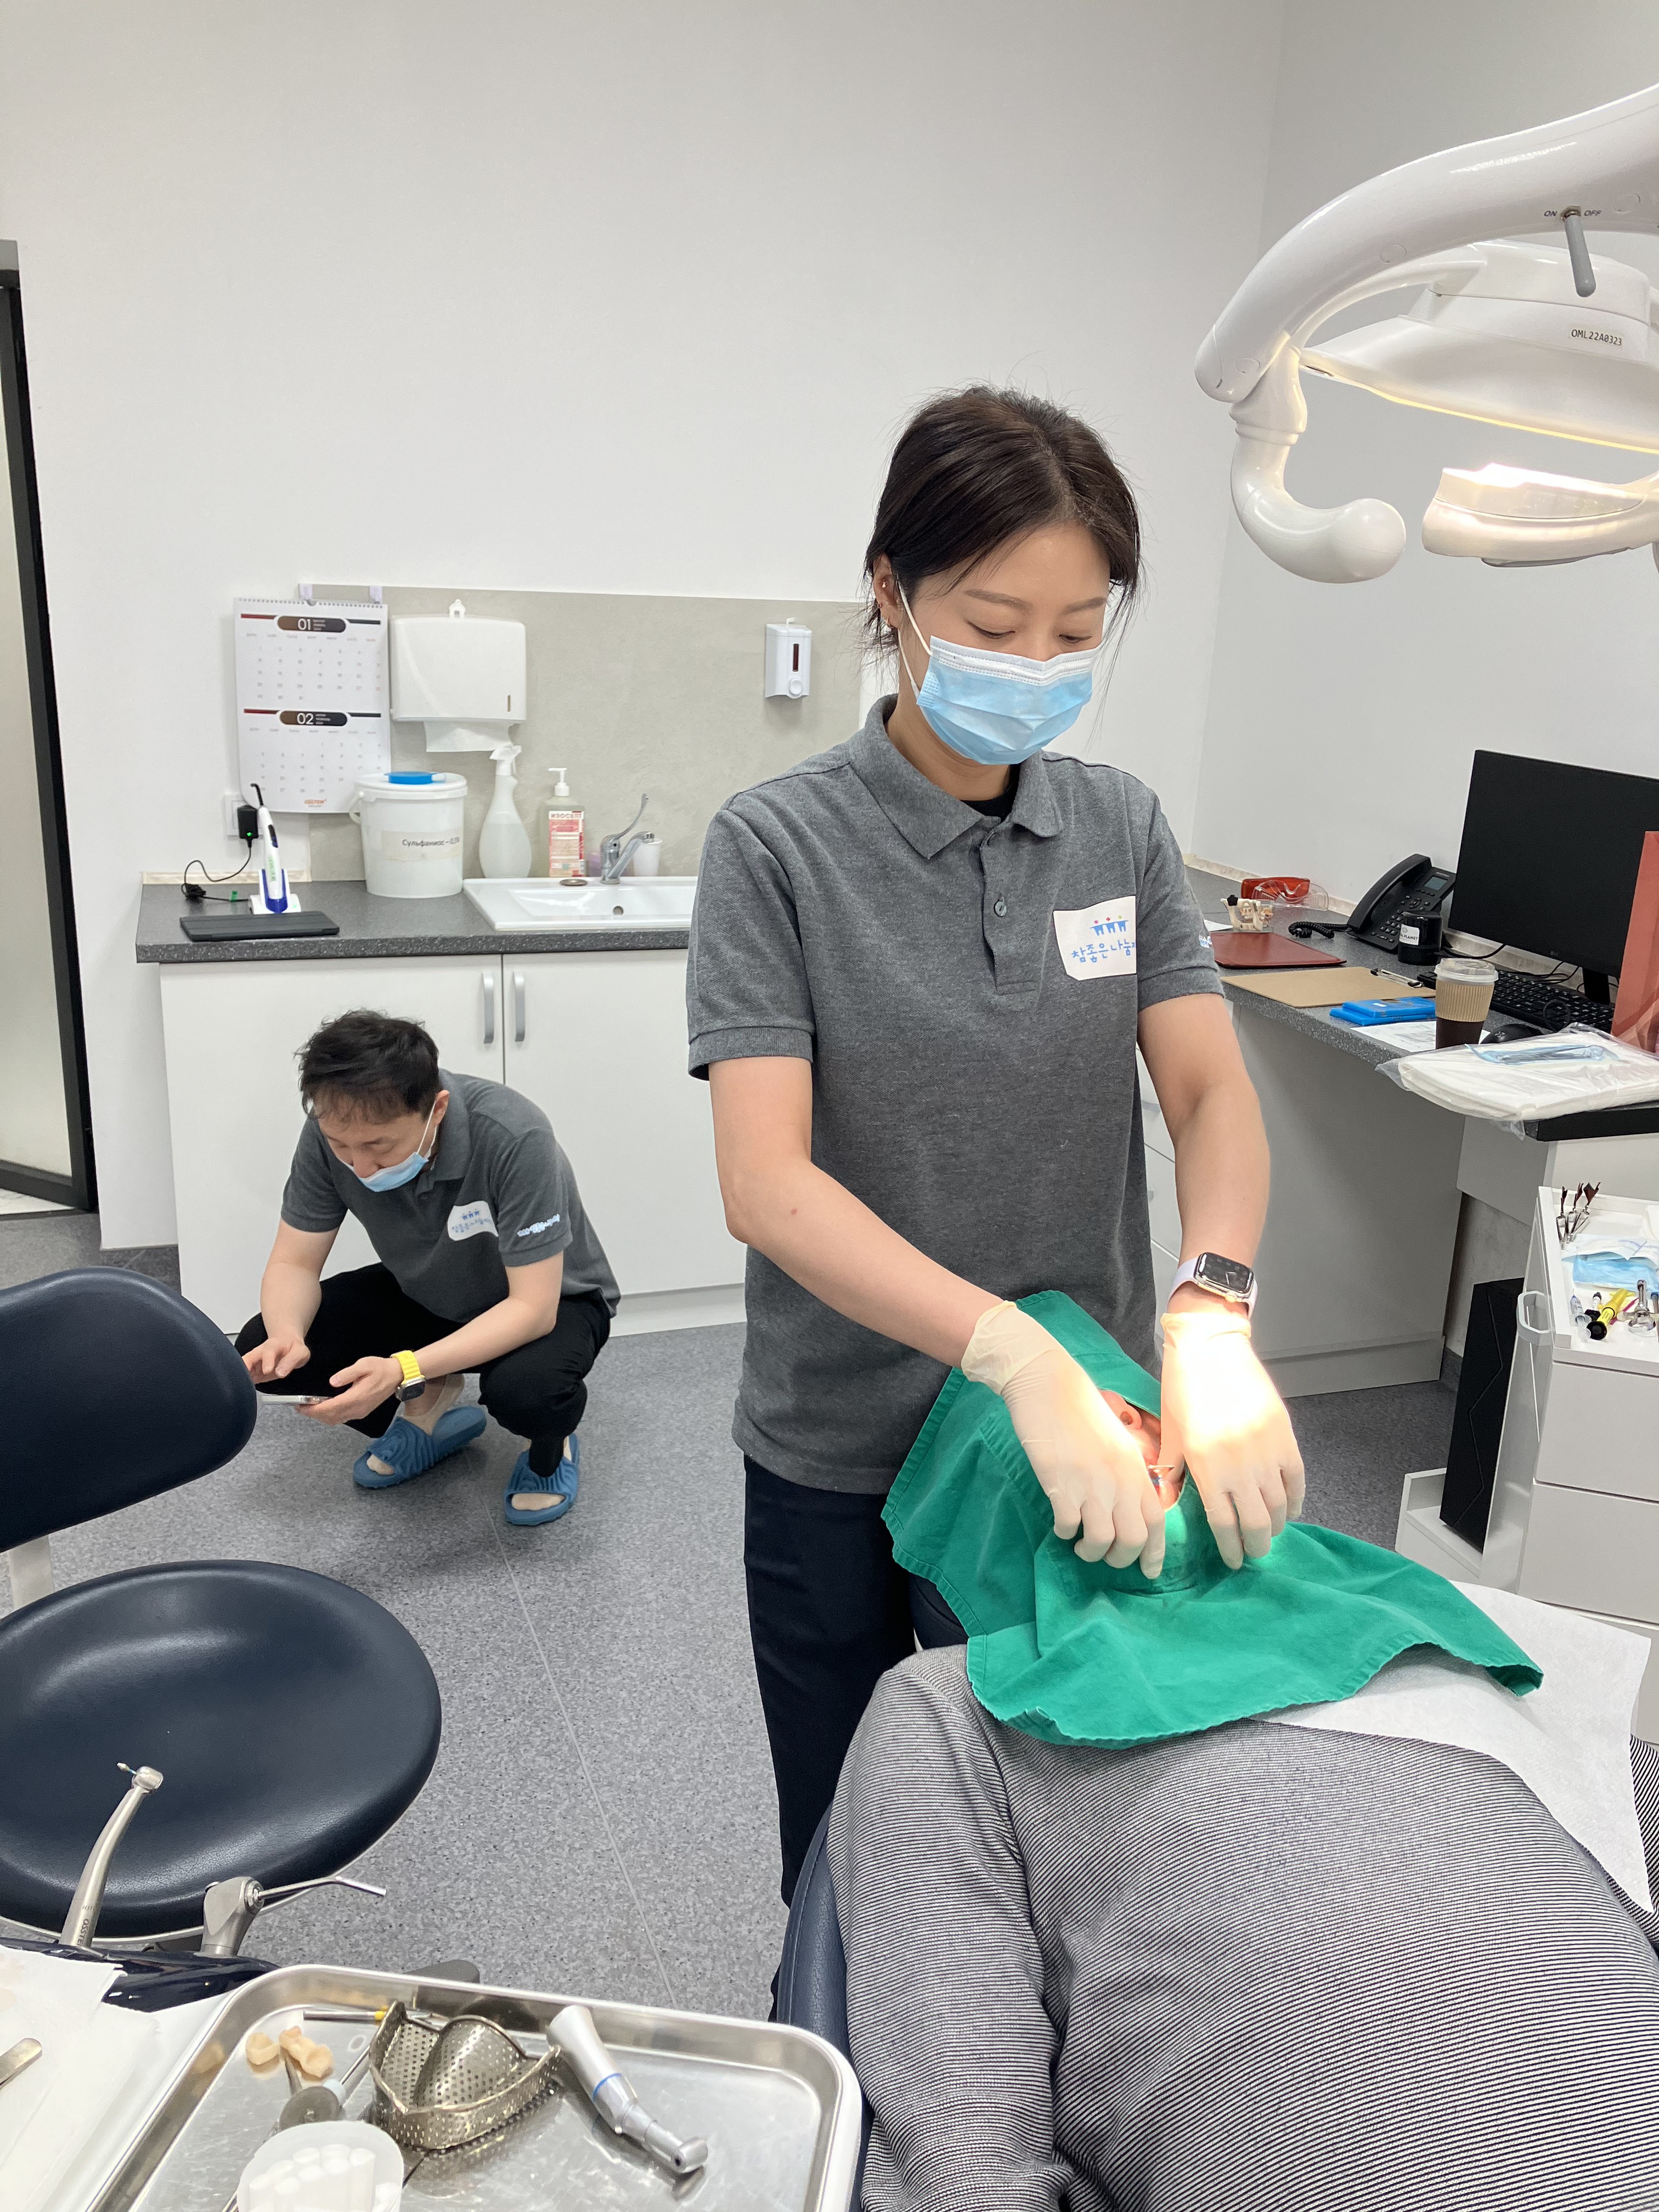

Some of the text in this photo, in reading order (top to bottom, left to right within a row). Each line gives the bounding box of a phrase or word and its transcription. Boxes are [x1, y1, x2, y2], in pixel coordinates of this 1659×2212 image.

[1571, 329, 1622, 346] OML22A0323
[297, 618, 311, 630] 01
[297, 712, 314, 725] 02
